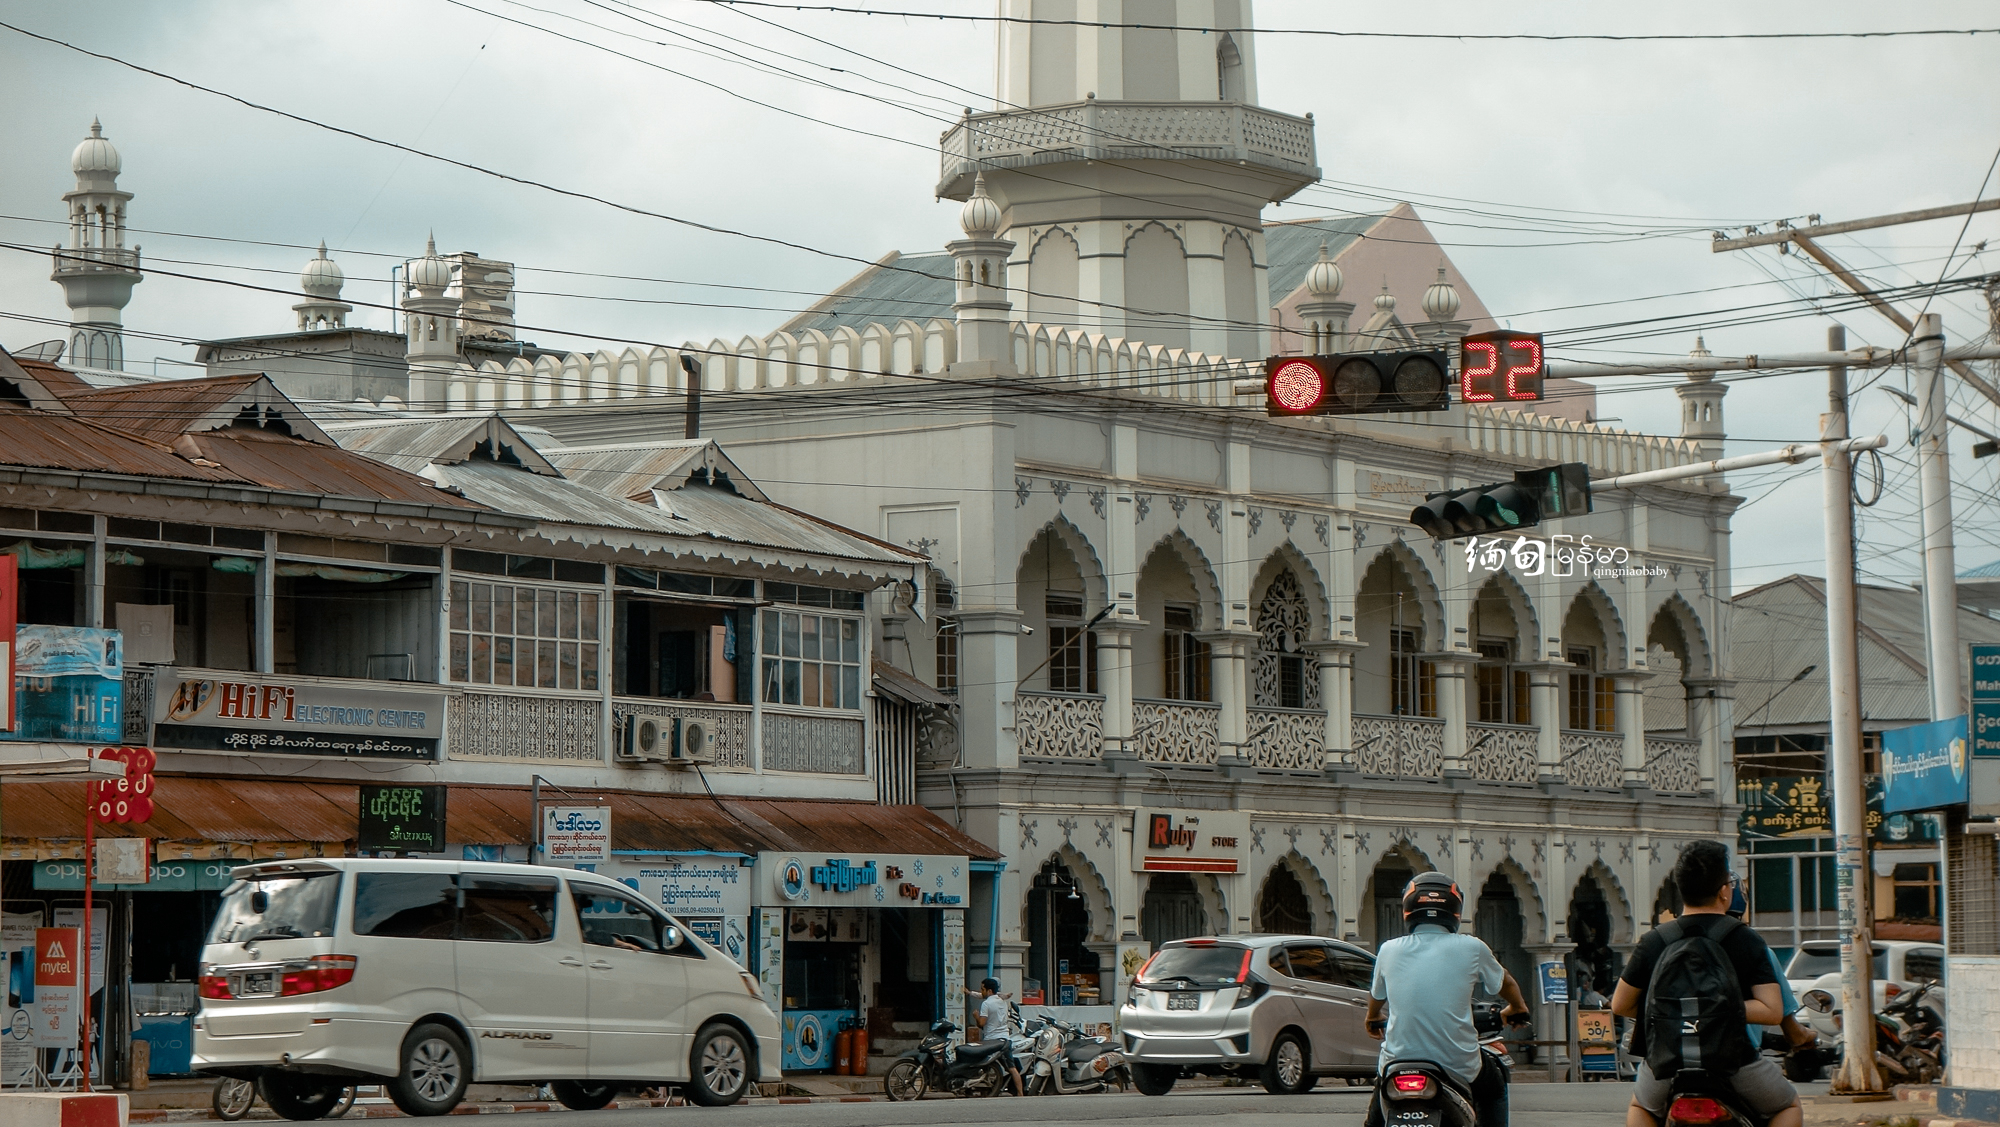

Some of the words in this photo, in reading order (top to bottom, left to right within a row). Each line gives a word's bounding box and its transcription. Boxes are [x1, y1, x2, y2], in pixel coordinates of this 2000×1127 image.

[1462, 339, 1542, 402] 22
[217, 682, 295, 721] HiFi
[296, 704, 374, 727] ELECTRONIC
[376, 708, 426, 729] CENTER
[1152, 814, 1198, 850] Ruby
[1212, 836, 1239, 848] STORE
[1185, 816, 1200, 825] Family
[41, 960, 70, 976] mytel
[480, 1030, 553, 1040] ALPHARD
